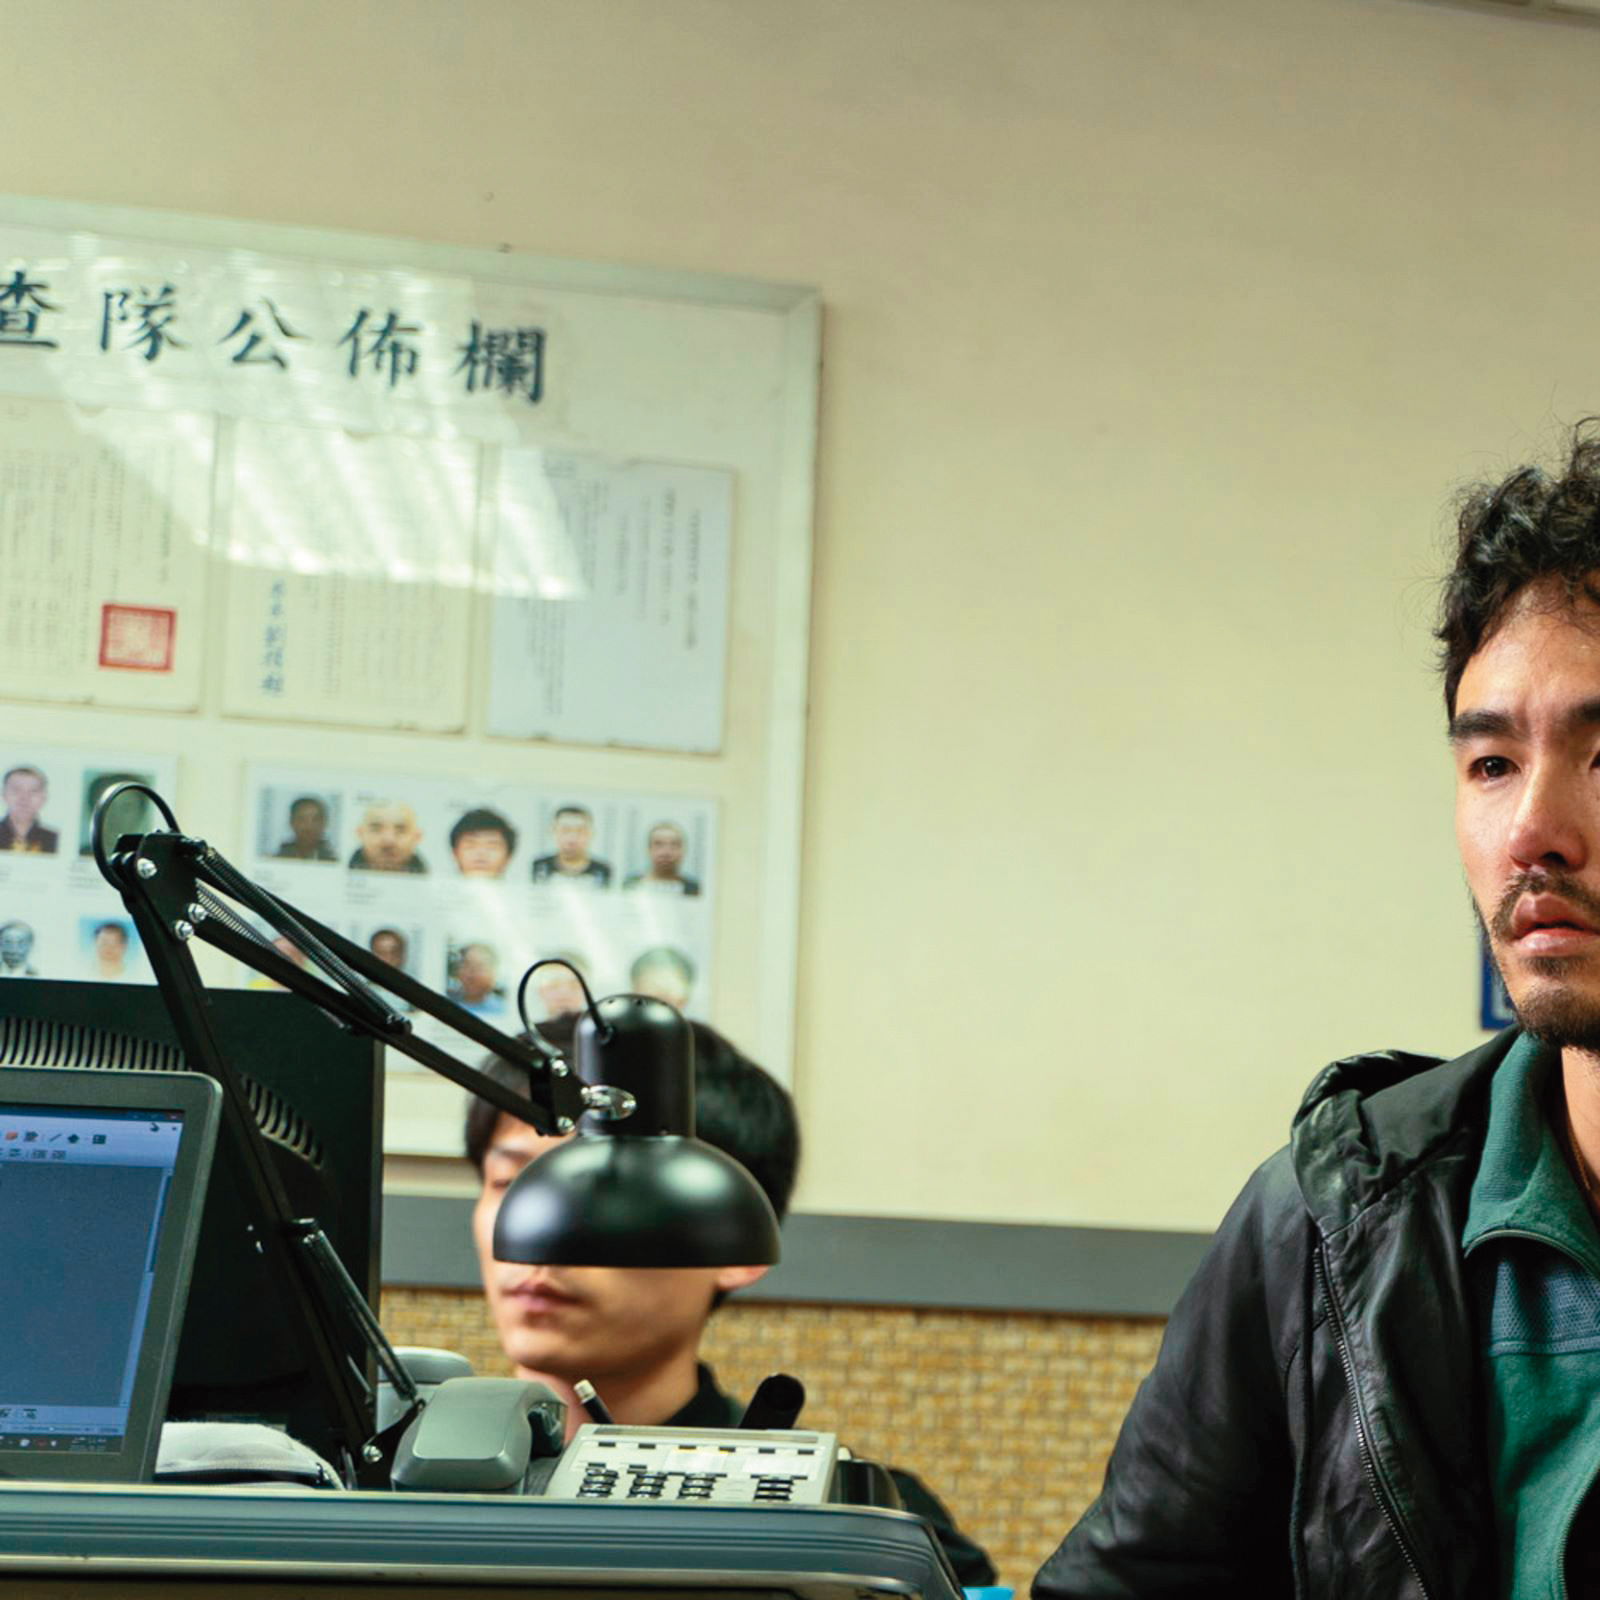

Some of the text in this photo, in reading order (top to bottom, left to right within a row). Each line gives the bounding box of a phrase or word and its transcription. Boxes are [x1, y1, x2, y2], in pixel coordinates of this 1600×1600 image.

[0, 270, 548, 404] 查隊公佈欄
